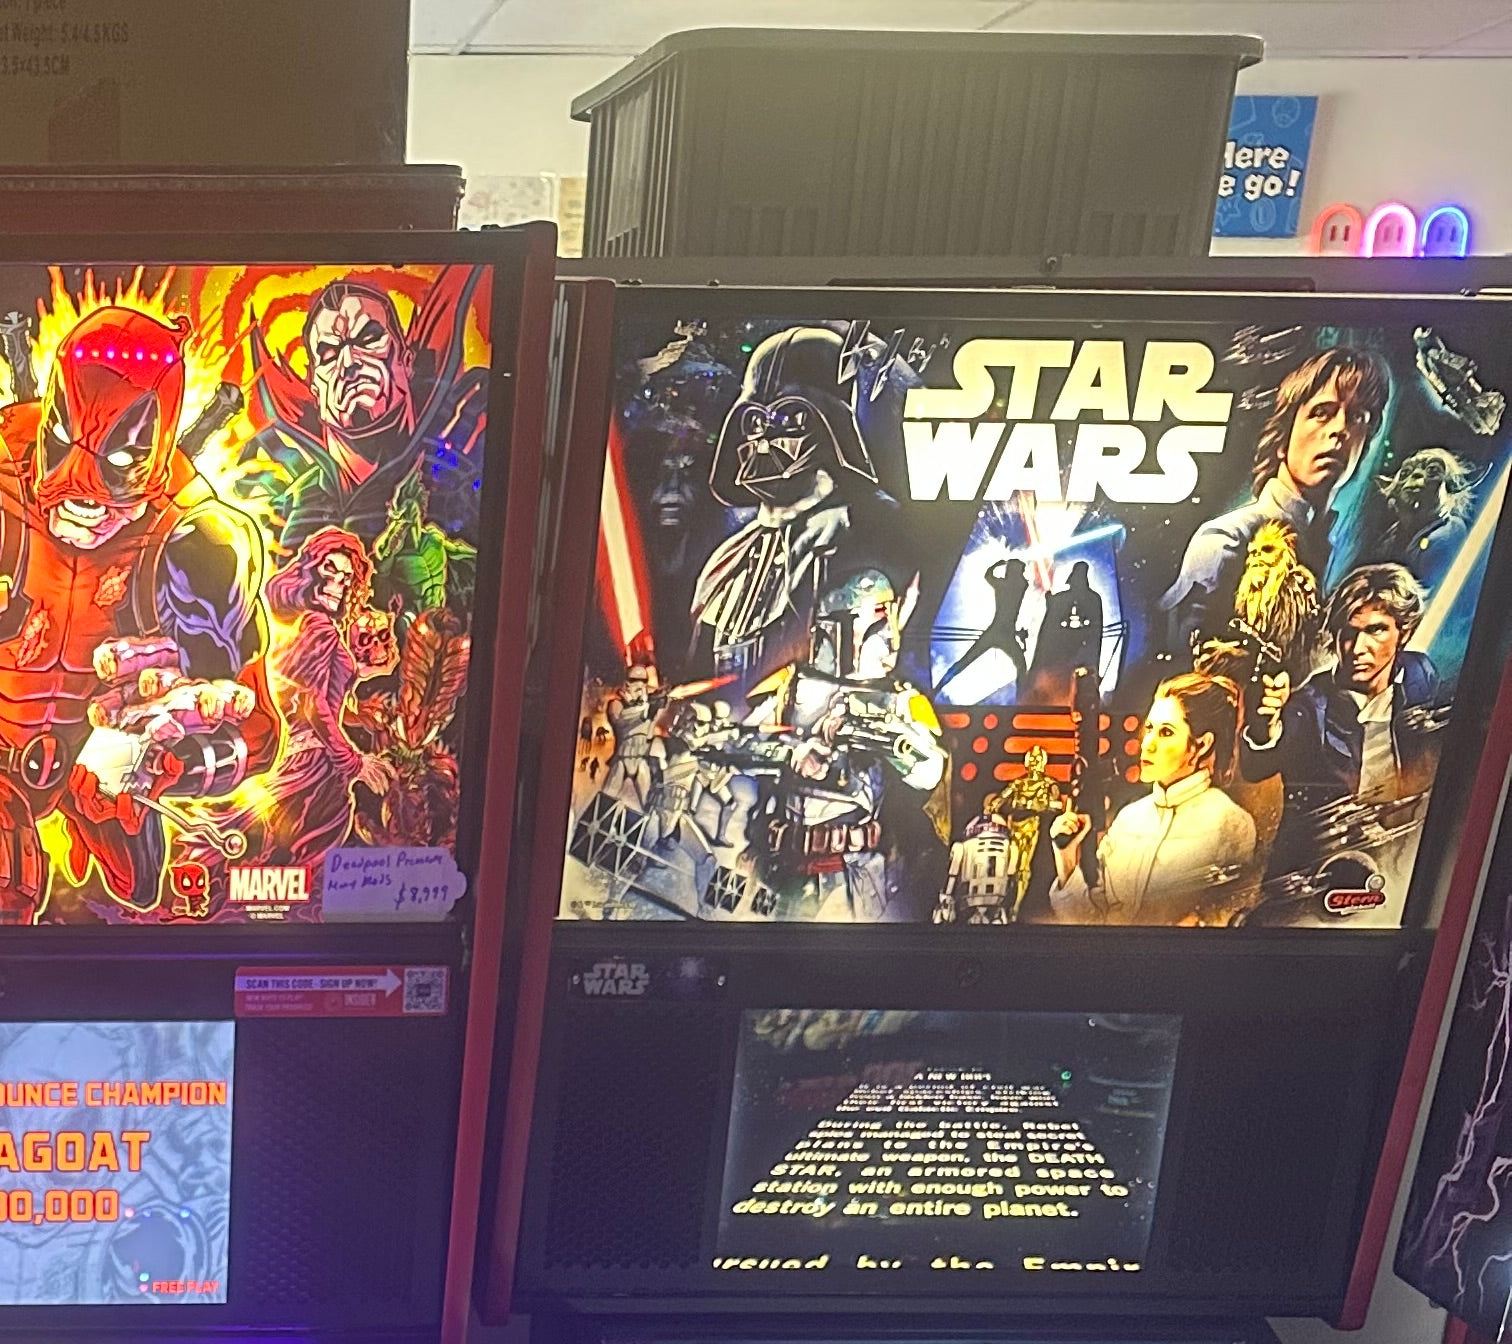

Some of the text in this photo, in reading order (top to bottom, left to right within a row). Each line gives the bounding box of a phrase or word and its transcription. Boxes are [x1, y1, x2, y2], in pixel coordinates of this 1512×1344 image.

[1244, 170, 1301, 201] go!
[904, 339, 1234, 422] STAR
[903, 421, 1228, 504] WARS
[330, 853, 391, 873] Deadpool
[230, 869, 310, 901] MARVEL
[393, 881, 449, 911] $8,999
[1330, 893, 1383, 907] Stern
[583, 963, 650, 980] STAR
[246, 979, 269, 989] SCAN
[271, 979, 290, 989] THIS
[292, 979, 313, 989] CODE
[342, 979, 353, 989] UP
[585, 978, 650, 996] WARS
[85, 1081, 228, 1107] CHAMPION
[883, 1140, 908, 1150] to
[928, 1140, 969, 1150] the
[784, 1151, 871, 1163] ultimate
[983, 1152, 1018, 1163] the
[1027, 1153, 1105, 1164] DEATH
[860, 1165, 893, 1177] an
[907, 1165, 1022, 1178] armored
[1035, 1167, 1116, 1181] space
[752, 1180, 1130, 1198] station with enough power to
[731, 1197, 1080, 1219] destroy an entire planet.
[152, 1281, 220, 1294] FREE PLAY
